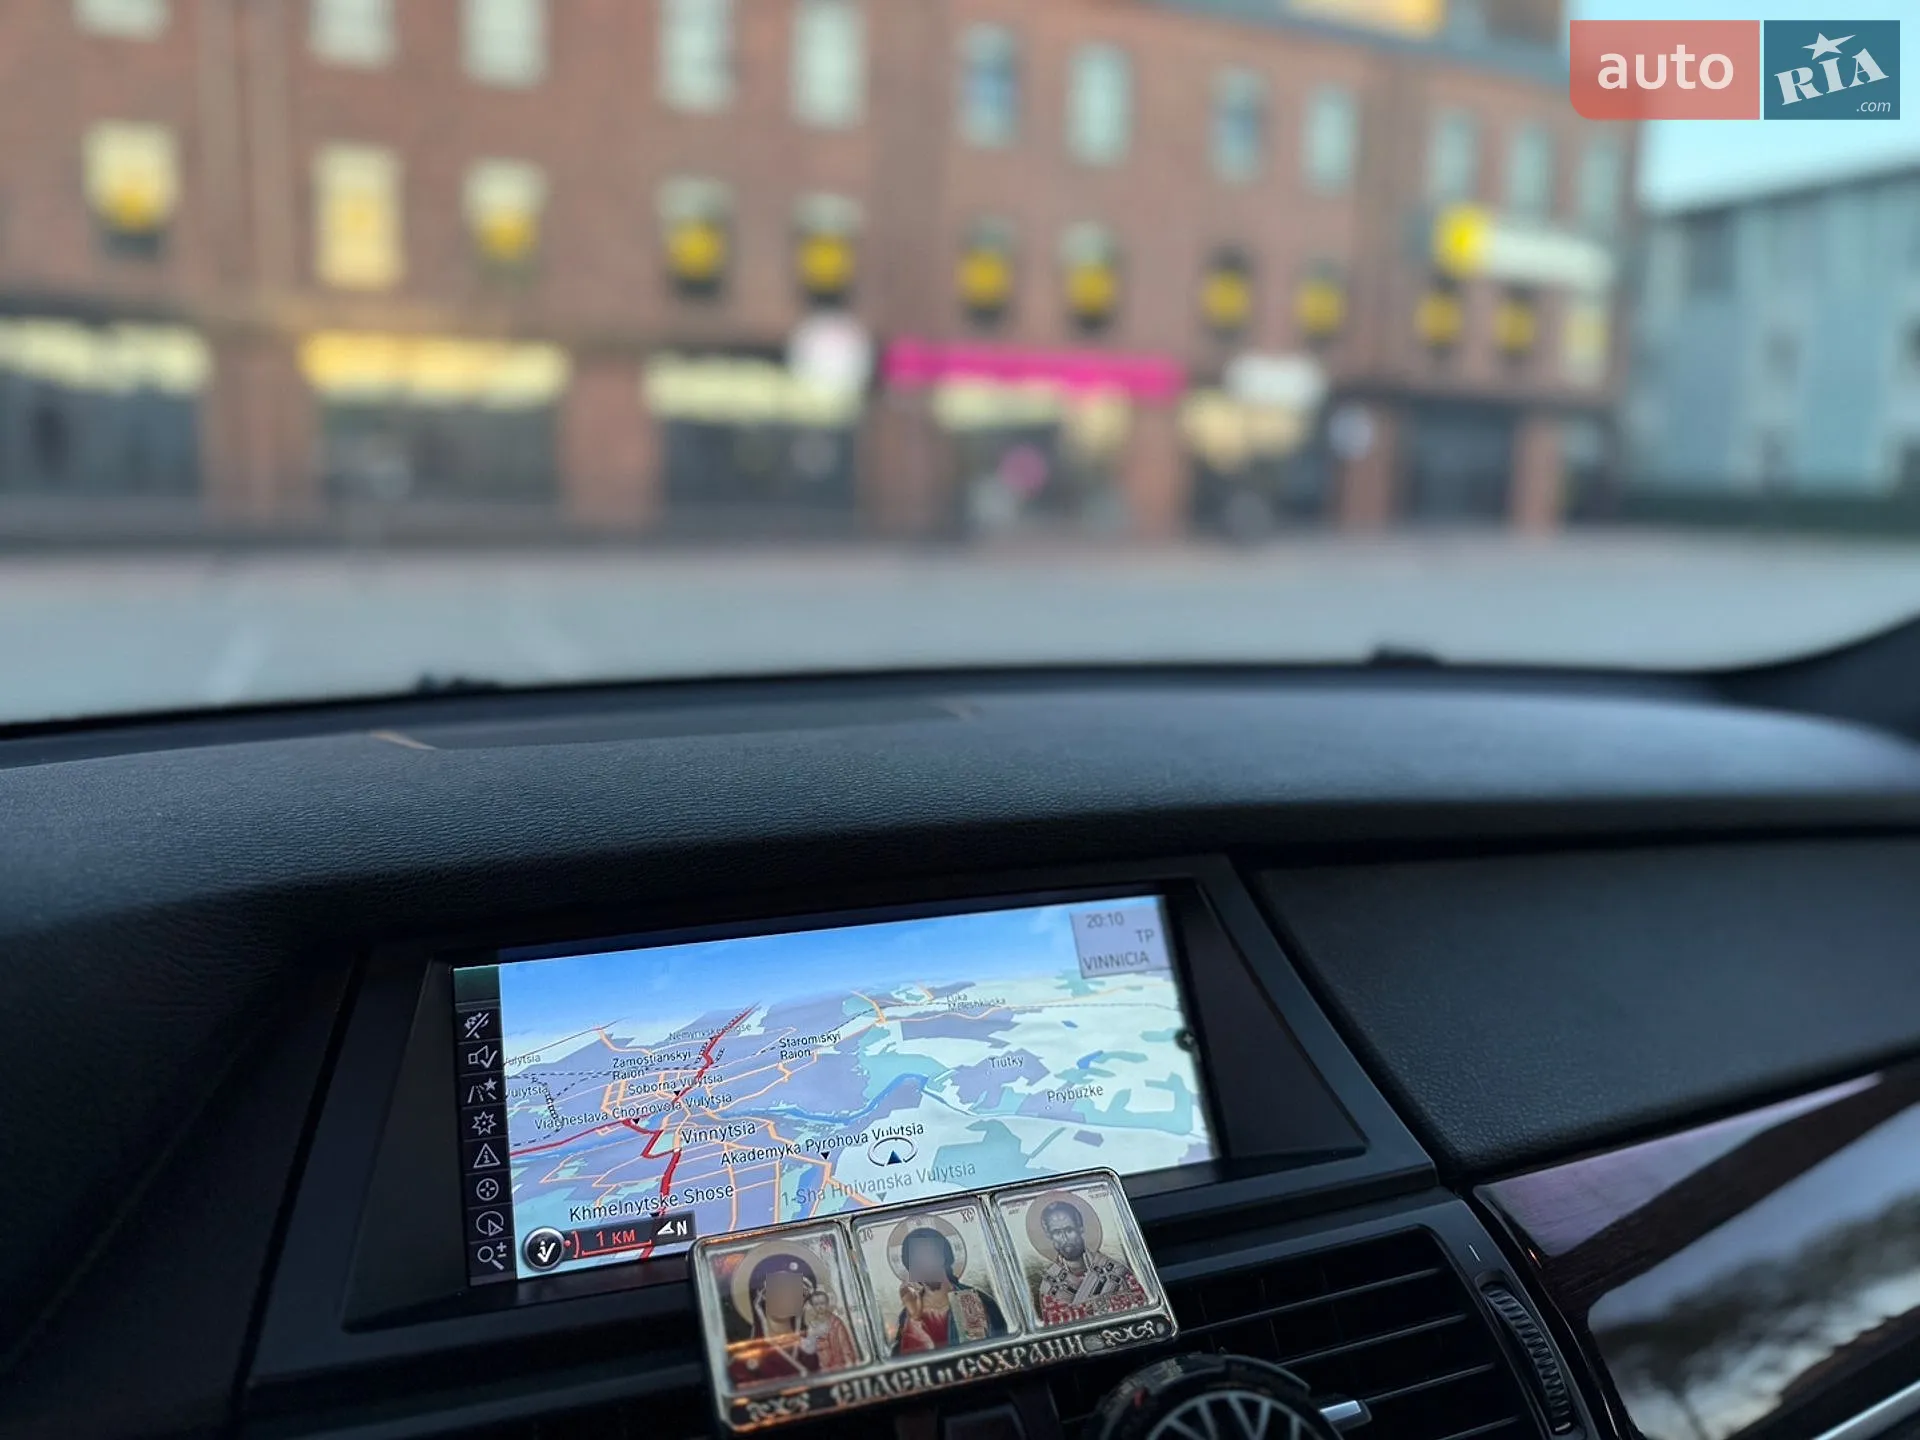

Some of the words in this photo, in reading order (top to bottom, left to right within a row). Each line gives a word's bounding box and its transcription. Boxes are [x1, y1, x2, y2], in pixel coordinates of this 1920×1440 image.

[1086, 912, 1124, 929] 20:10
[1136, 929, 1155, 944] TP
[1083, 951, 1149, 971] VINNICIA
[780, 1048, 811, 1060] Raion
[613, 1069, 645, 1081] Raion
[628, 1081, 676, 1096] Soborna
[679, 1073, 723, 1091] Vulytsia
[1047, 1085, 1104, 1104] Prybuzke
[534, 1112, 608, 1131] Viacheslava
[685, 1093, 732, 1111] Vulytsia
[682, 1122, 756, 1145] Vinnytsia
[721, 1143, 801, 1166] Akademyka
[805, 1133, 869, 1153] Pyrohova
[872, 1121, 924, 1140] Vulytsia
[831, 1173, 912, 1199] Hnivanska
[916, 1162, 976, 1183] Vulytsia
[570, 1194, 679, 1222] Khmelnytske
[684, 1184, 734, 1204] Shose
[596, 1231, 604, 1247] 1
[612, 1229, 636, 1245] KM
[676, 1220, 688, 1236] N
[956, 1334, 1087, 1379] СОХРАНИ
